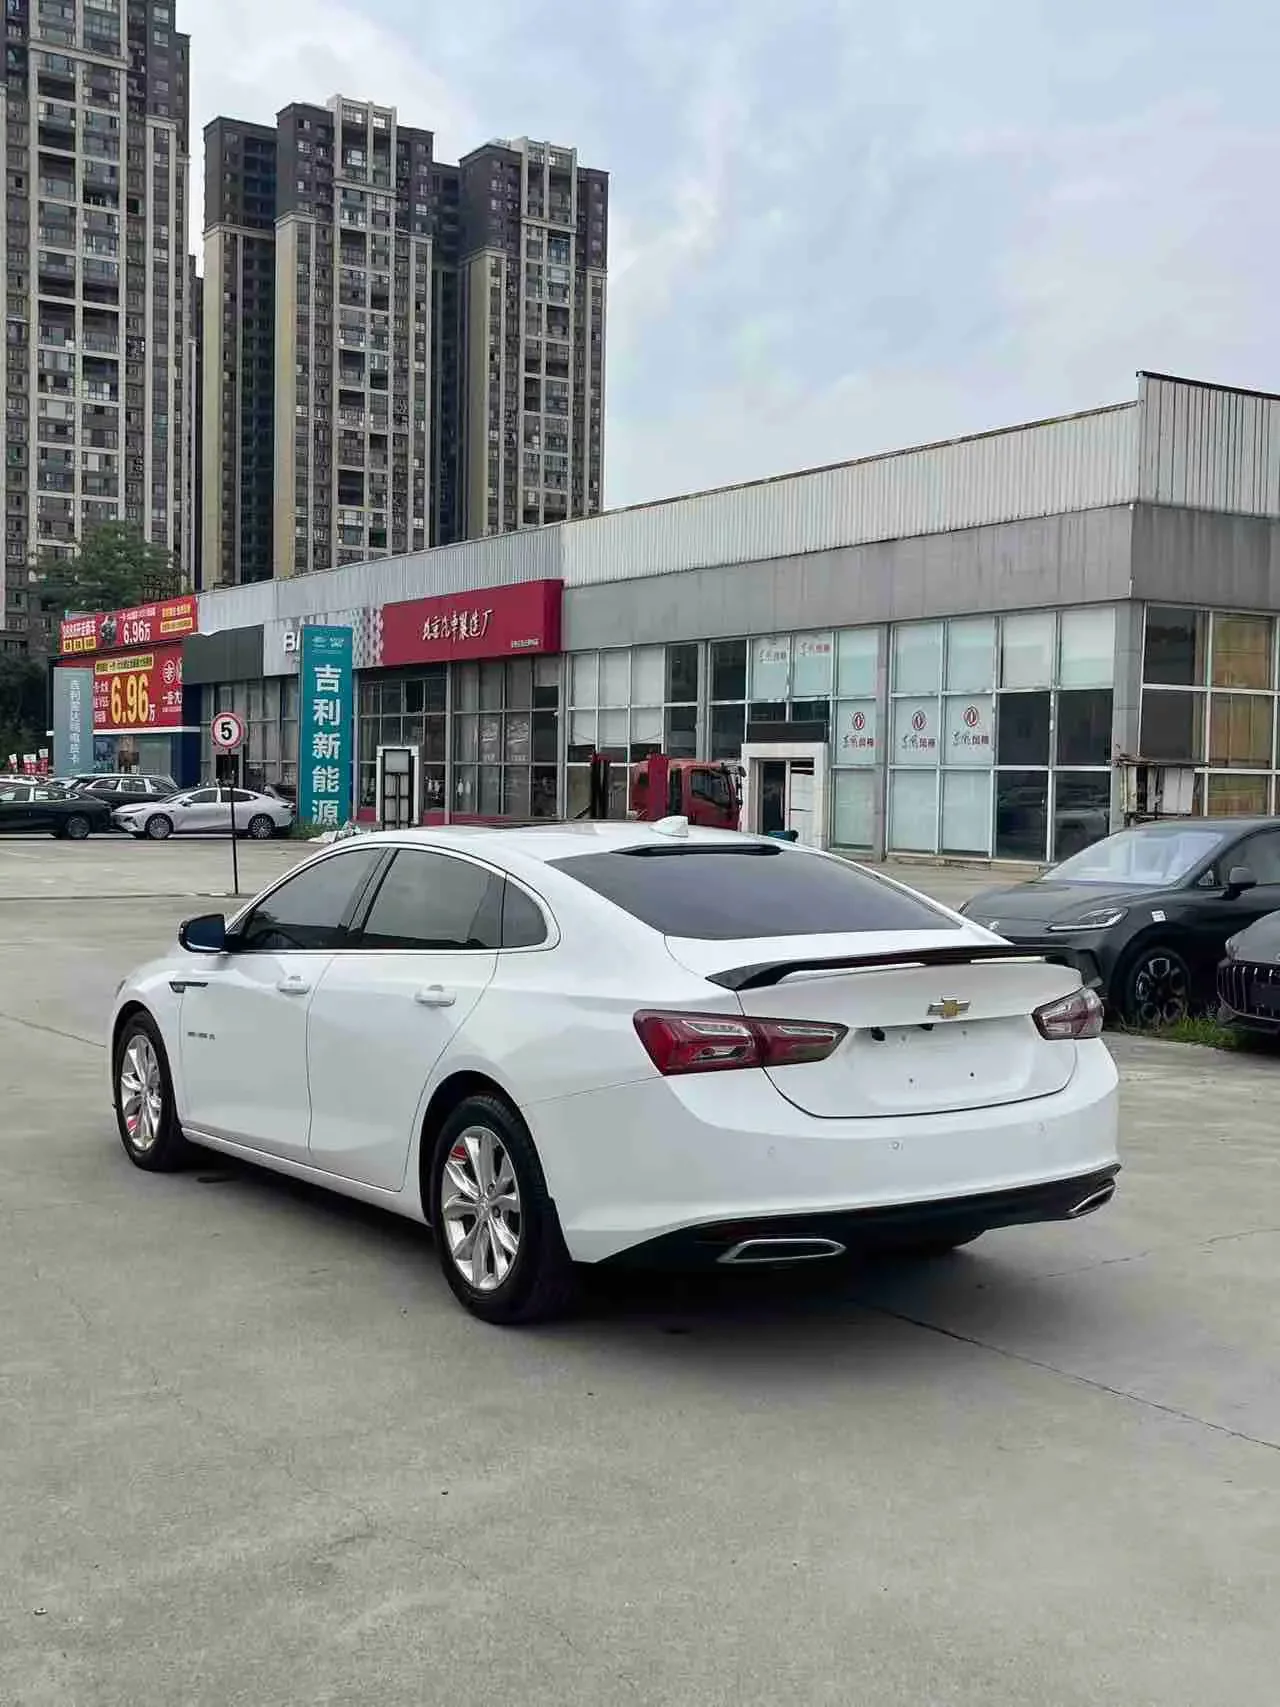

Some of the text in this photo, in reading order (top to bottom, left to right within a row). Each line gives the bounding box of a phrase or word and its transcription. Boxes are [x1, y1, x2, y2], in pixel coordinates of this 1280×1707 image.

[123, 620, 151, 644] 6.96万
[111, 673, 156, 724] 6.96万
[221, 721, 233, 740] 5
[312, 664, 342, 825] 吉利新能源
